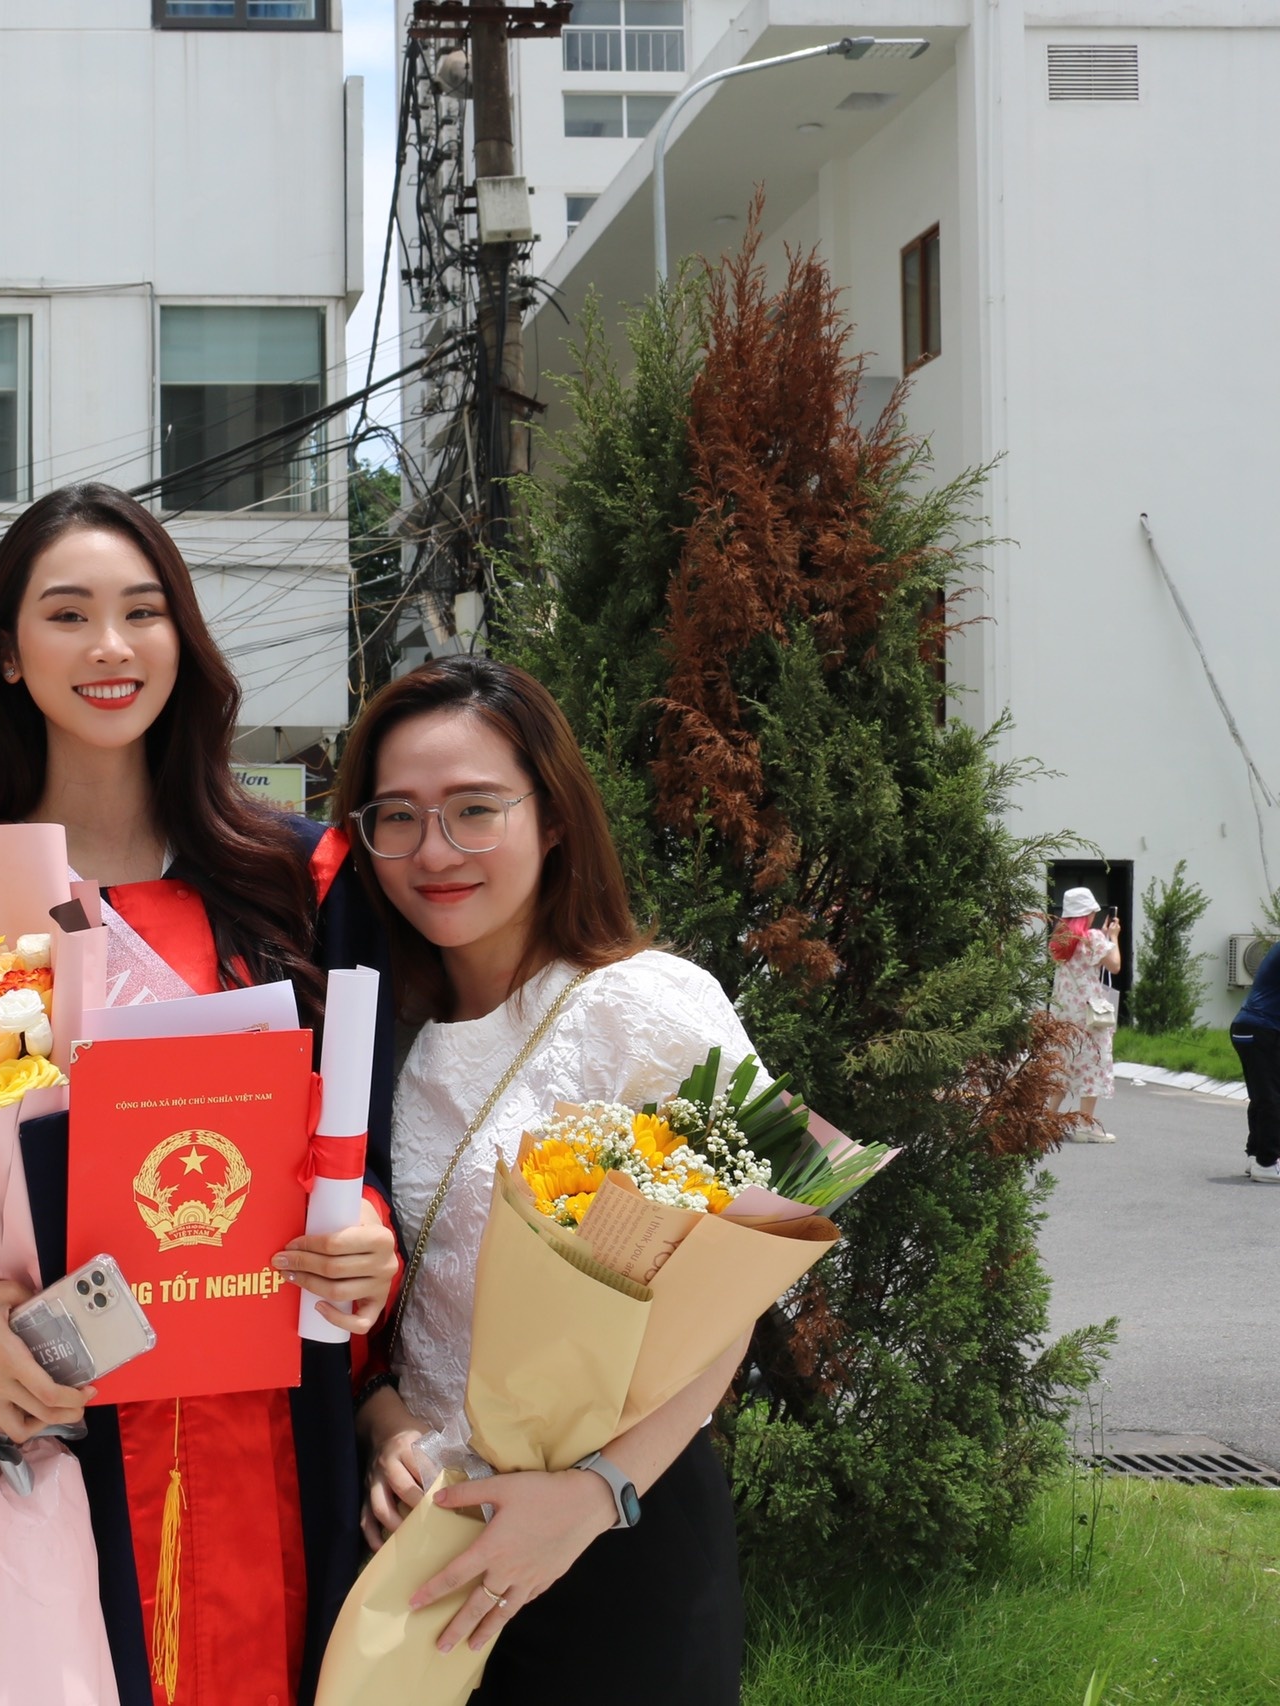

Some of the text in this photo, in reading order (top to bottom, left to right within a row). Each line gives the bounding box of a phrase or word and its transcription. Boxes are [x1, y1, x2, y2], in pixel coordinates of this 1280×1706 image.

[115, 1093, 273, 1111] CỘNG HÒA XÃ HỘI CHỦ NGHĨA VIỆT NAM
[640, 1220, 661, 1245] think
[628, 1241, 646, 1262] you
[621, 1262, 635, 1278] are
[159, 1270, 200, 1303] TỐT
[205, 1266, 286, 1299] NGHIỆP
[39, 1340, 75, 1365] GUEST
